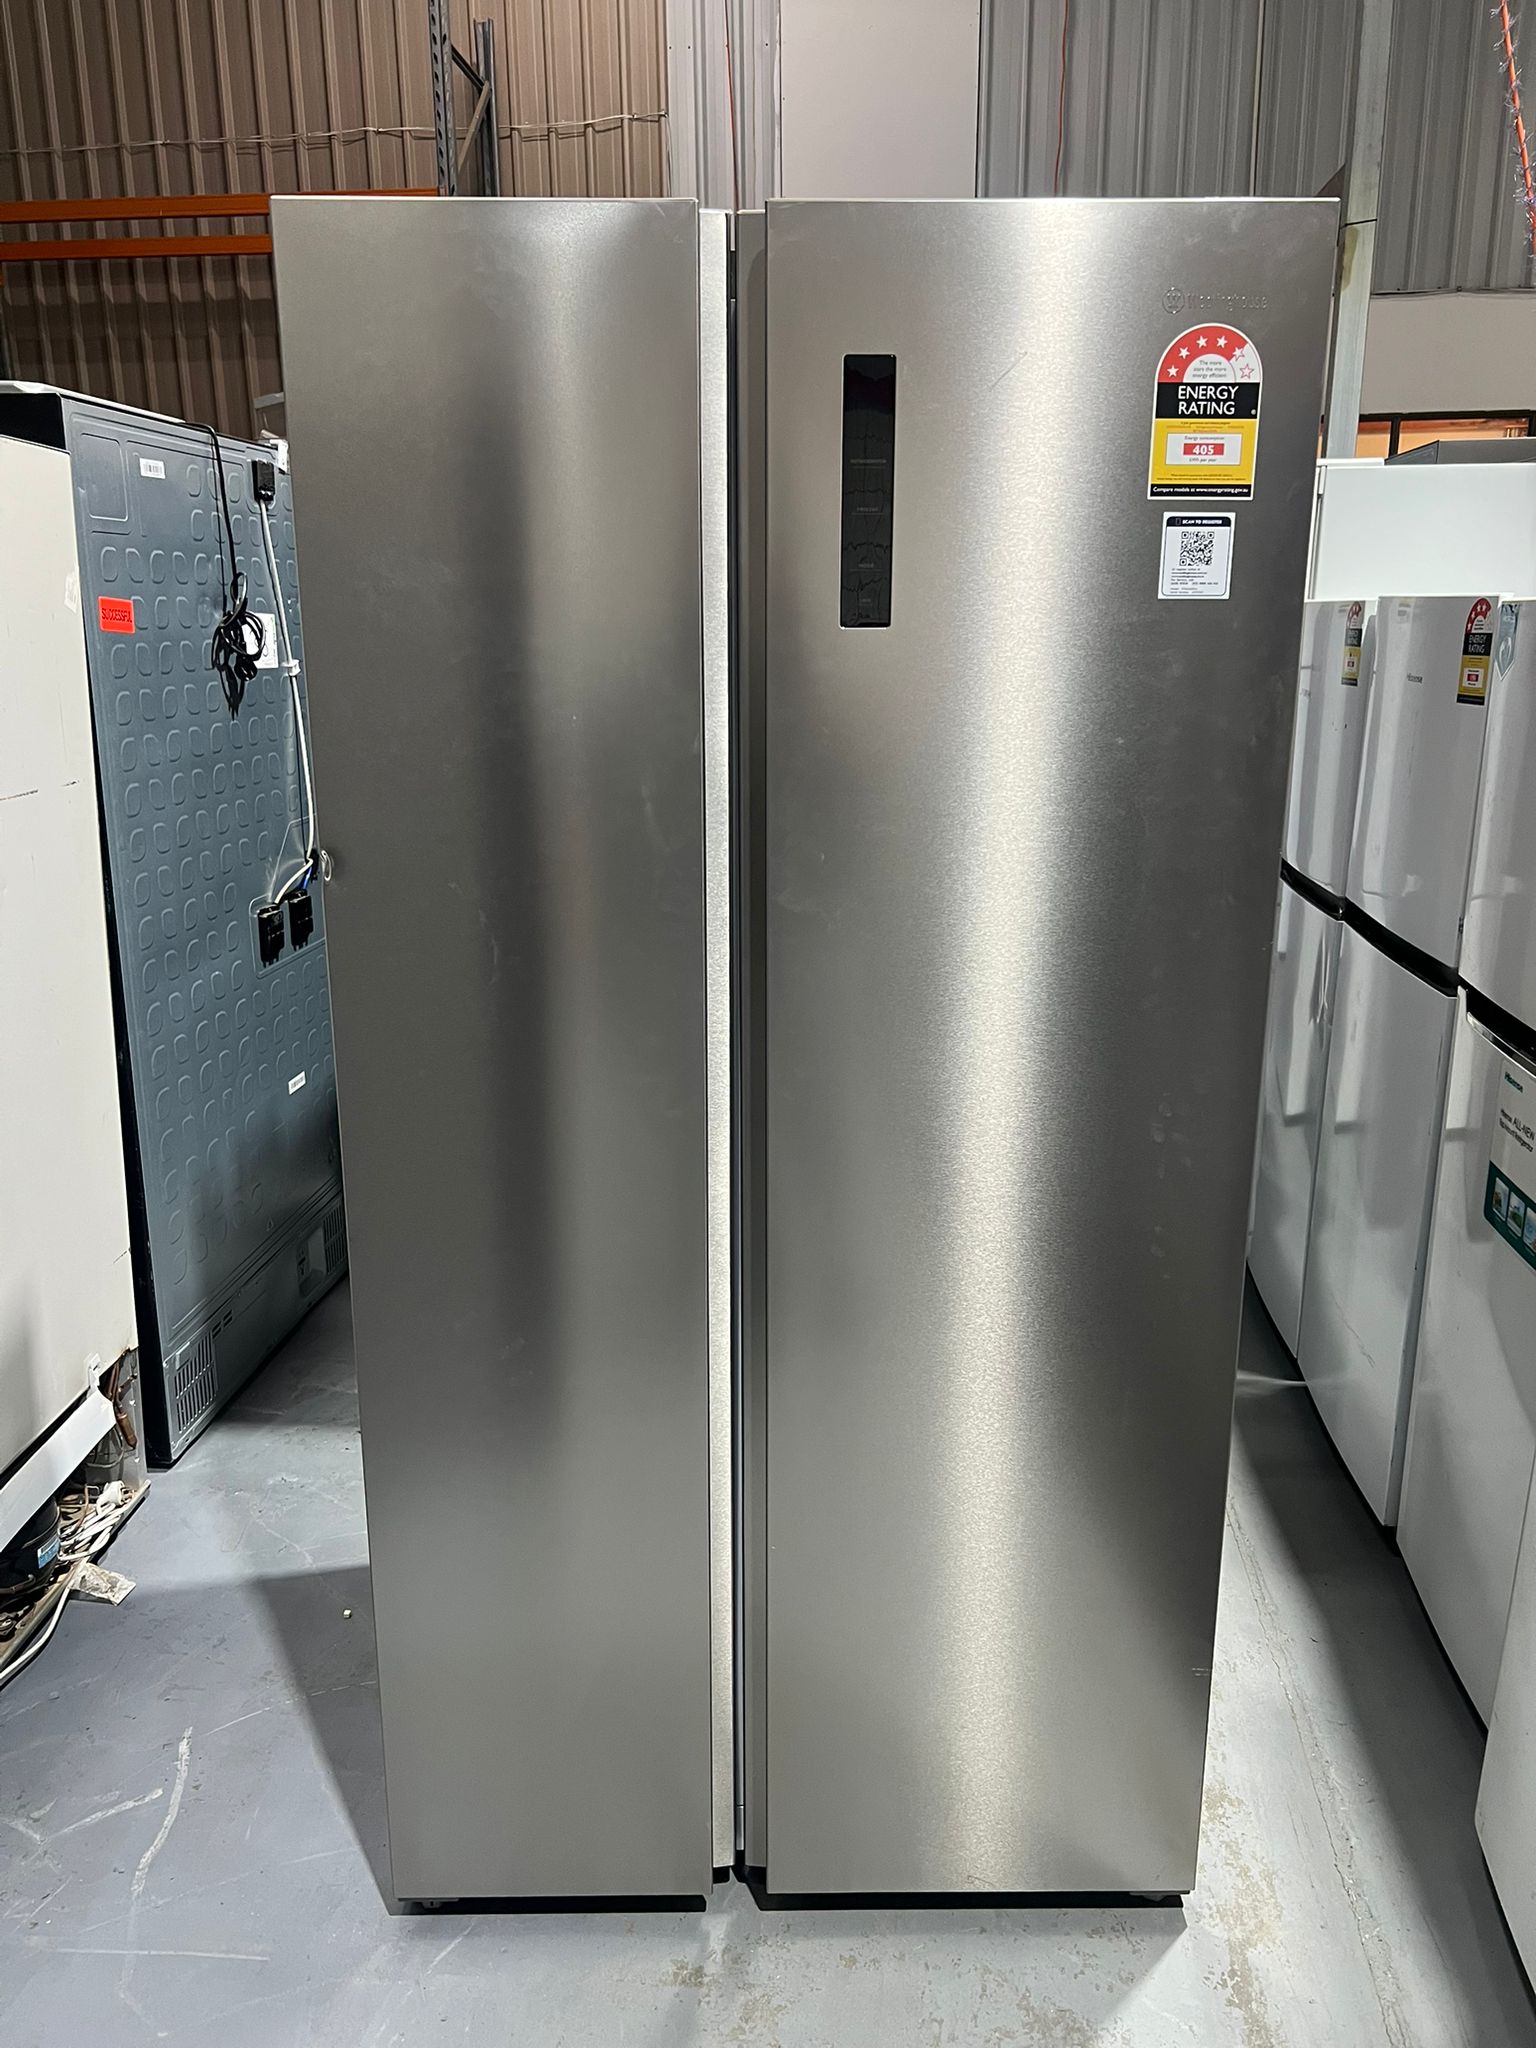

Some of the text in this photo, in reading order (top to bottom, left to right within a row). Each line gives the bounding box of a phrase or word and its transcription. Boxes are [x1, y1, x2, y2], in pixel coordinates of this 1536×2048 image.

[1177, 385, 1239, 400] ENERGY
[1178, 400, 1235, 415] RATING
[1193, 445, 1214, 455] 405
